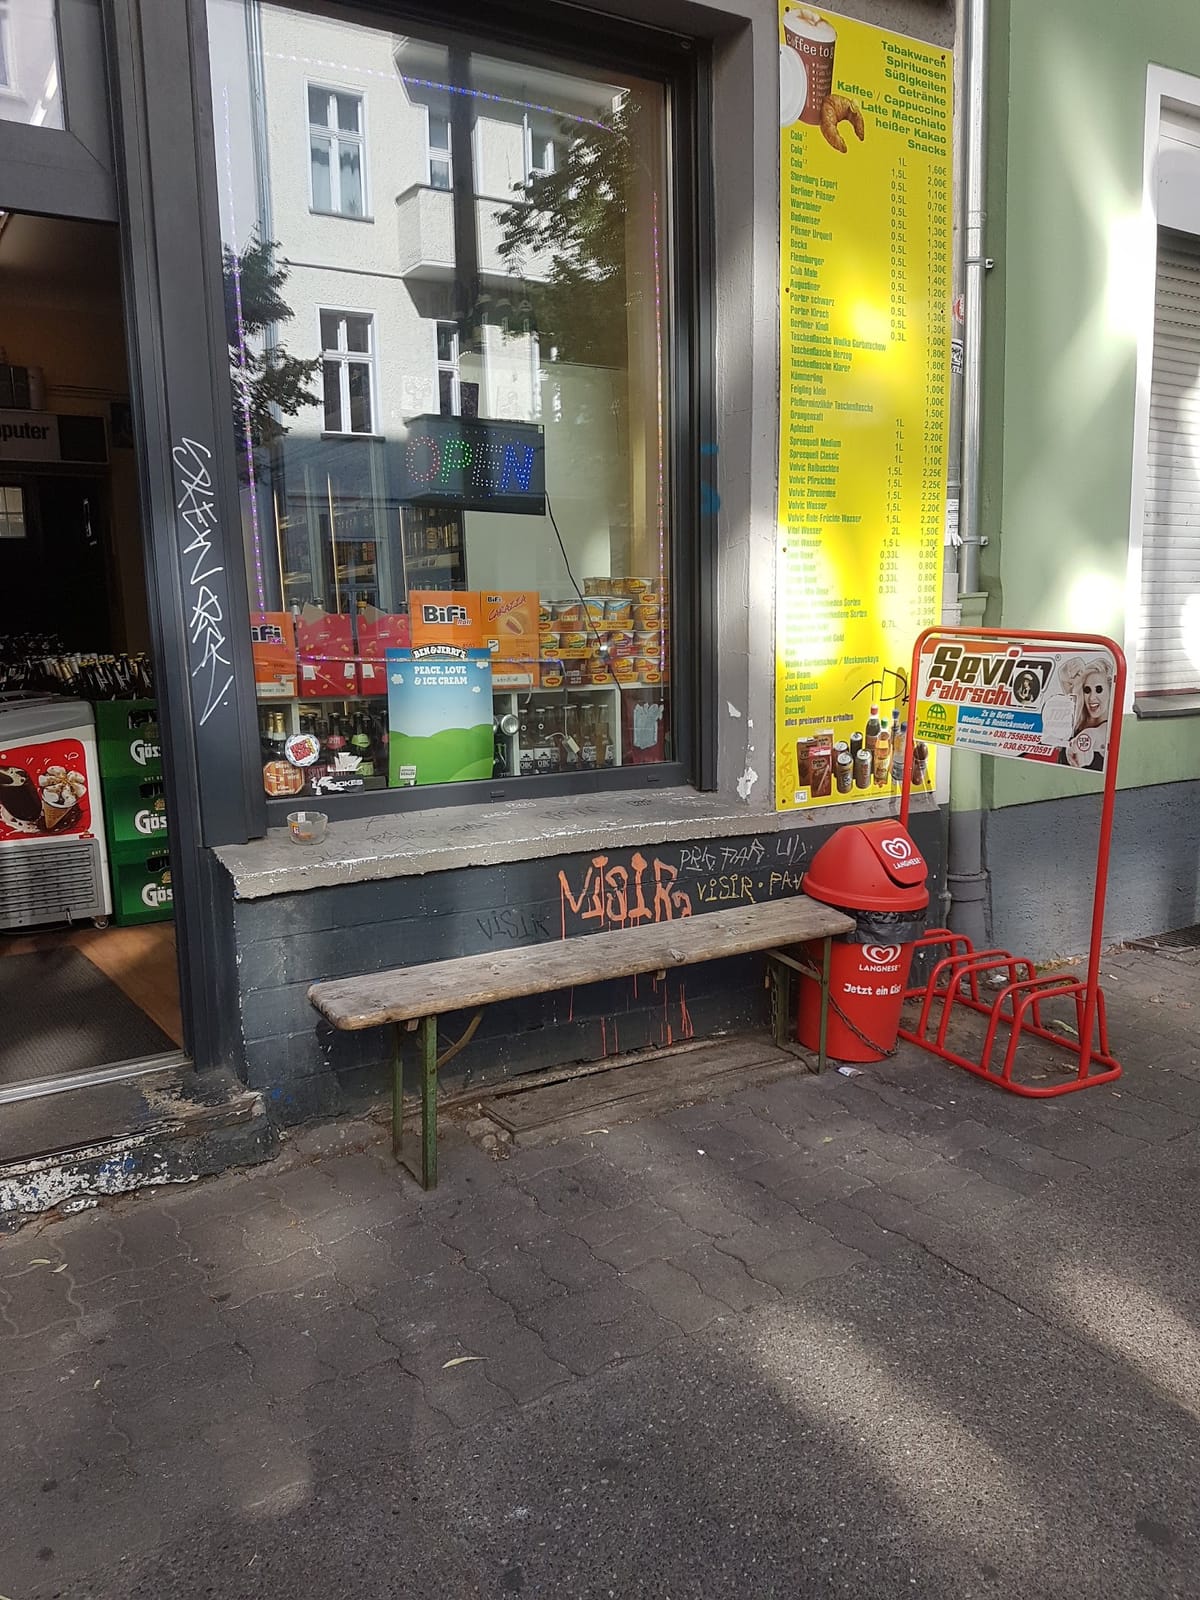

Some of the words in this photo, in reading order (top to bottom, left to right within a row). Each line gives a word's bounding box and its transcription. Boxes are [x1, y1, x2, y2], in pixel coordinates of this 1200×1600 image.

[882, 41, 946, 68] Tabakwaren
[886, 56, 946, 81] Spirituosen
[884, 68, 946, 94] Süßigkeiten
[837, 80, 874, 98] Kaffee
[884, 94, 946, 118] Cappuccino
[898, 85, 946, 106] Getränke
[861, 101, 888, 116] Latte
[892, 110, 946, 131] Macchiato
[876, 118, 910, 135] heißer
[914, 128, 946, 144] Kakao
[790, 130, 802, 141] Cola
[898, 157, 906, 166] 1L
[928, 164, 946, 176] 1,60€
[908, 139, 946, 156] Snacks
[790, 143, 802, 155] Cola
[892, 168, 906, 179] 1,5L
[927, 176, 946, 188] 2,00€
[790, 157, 802, 168] Cola
[891, 180, 906, 192] 0,5L
[928, 189, 946, 200] 1,10€
[890, 193, 906, 204] 0,5L
[927, 201, 946, 213] 0,70€
[891, 206, 906, 217] 0,5L
[928, 214, 946, 225] 1,00€
[890, 218, 906, 229] 0,5L
[928, 226, 946, 237] 1,30€
[890, 231, 906, 242] 0,5L
[928, 238, 946, 249] 1,30€
[790, 238, 807, 249] Becks
[890, 256, 906, 267] 0,5L
[928, 263, 946, 274] 1,30€
[890, 244, 906, 254] 0,5L
[928, 250, 946, 262] 1,30€
[890, 269, 906, 279] 0,5L
[927, 275, 946, 286] 1,40€
[890, 281, 906, 292] 0,5L
[927, 287, 946, 298] 1,20€
[890, 294, 906, 304] 0,5L
[927, 300, 946, 311] 1,40€
[890, 306, 906, 317] 0,5L
[927, 312, 945, 322] 1,30€
[890, 319, 906, 329] 0,5L
[927, 324, 945, 334] 1,30€
[927, 336, 945, 346] 1,00€
[927, 348, 945, 358] 1,80€
[926, 360, 944, 370] 1,80€
[926, 372, 944, 382] 1,80€
[926, 385, 944, 394] 1,00€
[926, 397, 944, 406] 1,00€
[925, 408, 944, 418] 1,50€
[896, 418, 904, 427] 1L
[924, 420, 943, 430] 2,20€
[895, 430, 904, 439] 1L
[924, 432, 942, 441] 2,20€
[895, 442, 903, 451] 1L
[924, 444, 942, 453] 1,10€
[406, 436, 534, 490] OPEN
[894, 454, 903, 463] 1L
[924, 456, 941, 465] 1,10€
[888, 466, 902, 476] 1,5L
[922, 468, 941, 477] 2,25€
[887, 478, 902, 488] 1,5L
[922, 480, 940, 489] 2,25€
[887, 490, 901, 500] 1,5L
[921, 492, 940, 500] 2,25€
[886, 502, 901, 512] 1,5L
[921, 503, 939, 512] 2,20€
[886, 514, 900, 524] 1,5L
[920, 515, 939, 523] 2,20€
[891, 526, 900, 535] 2L
[920, 527, 938, 535] 1,50€
[920, 538, 938, 546] 1,30€
[918, 550, 937, 558] 0,80€
[424, 606, 466, 624] BiFi
[251, 624, 281, 642] iFi
[414, 666, 444, 674] PEACE,
[962, 715, 983, 726] Wedding
[991, 719, 1035, 730] Reinickendorf
[996, 711, 1014, 719] Berlin
[918, 730, 952, 741] INTERNET
[130, 740, 161, 766] Gös
[1002, 741, 1052, 754] 030.65770591
[893, 858, 921, 870] LANGNESE
[859, 964, 898, 972] LANGNESE
[843, 983, 872, 995] Jetzt
[876, 985, 888, 995] ein
